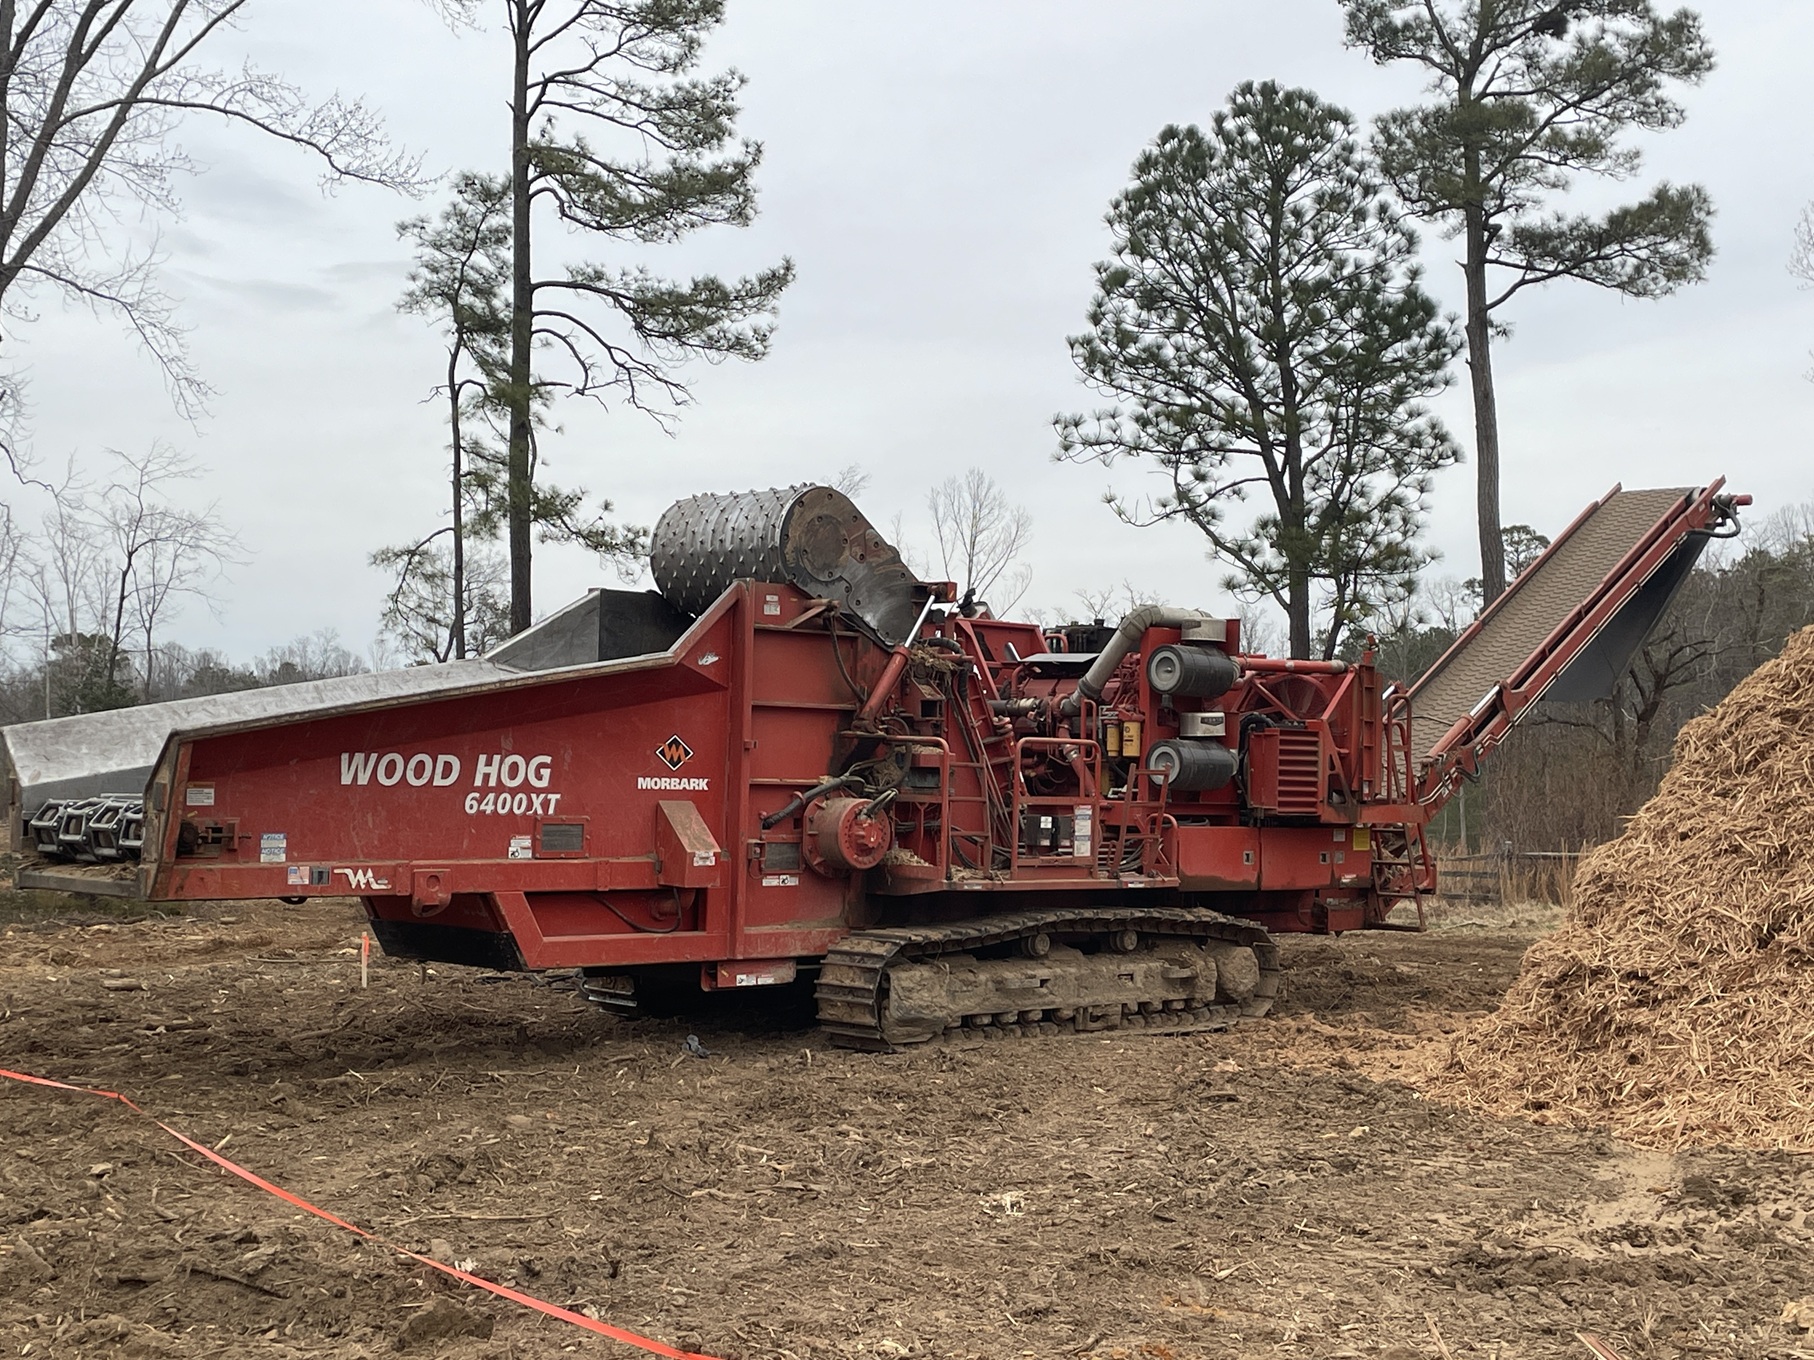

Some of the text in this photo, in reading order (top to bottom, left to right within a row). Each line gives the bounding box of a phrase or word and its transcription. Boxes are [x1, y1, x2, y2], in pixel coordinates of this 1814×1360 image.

[340, 752, 552, 788] WOOD HOG
[637, 777, 709, 791] MORBARK
[464, 792, 561, 815] 6400XT
